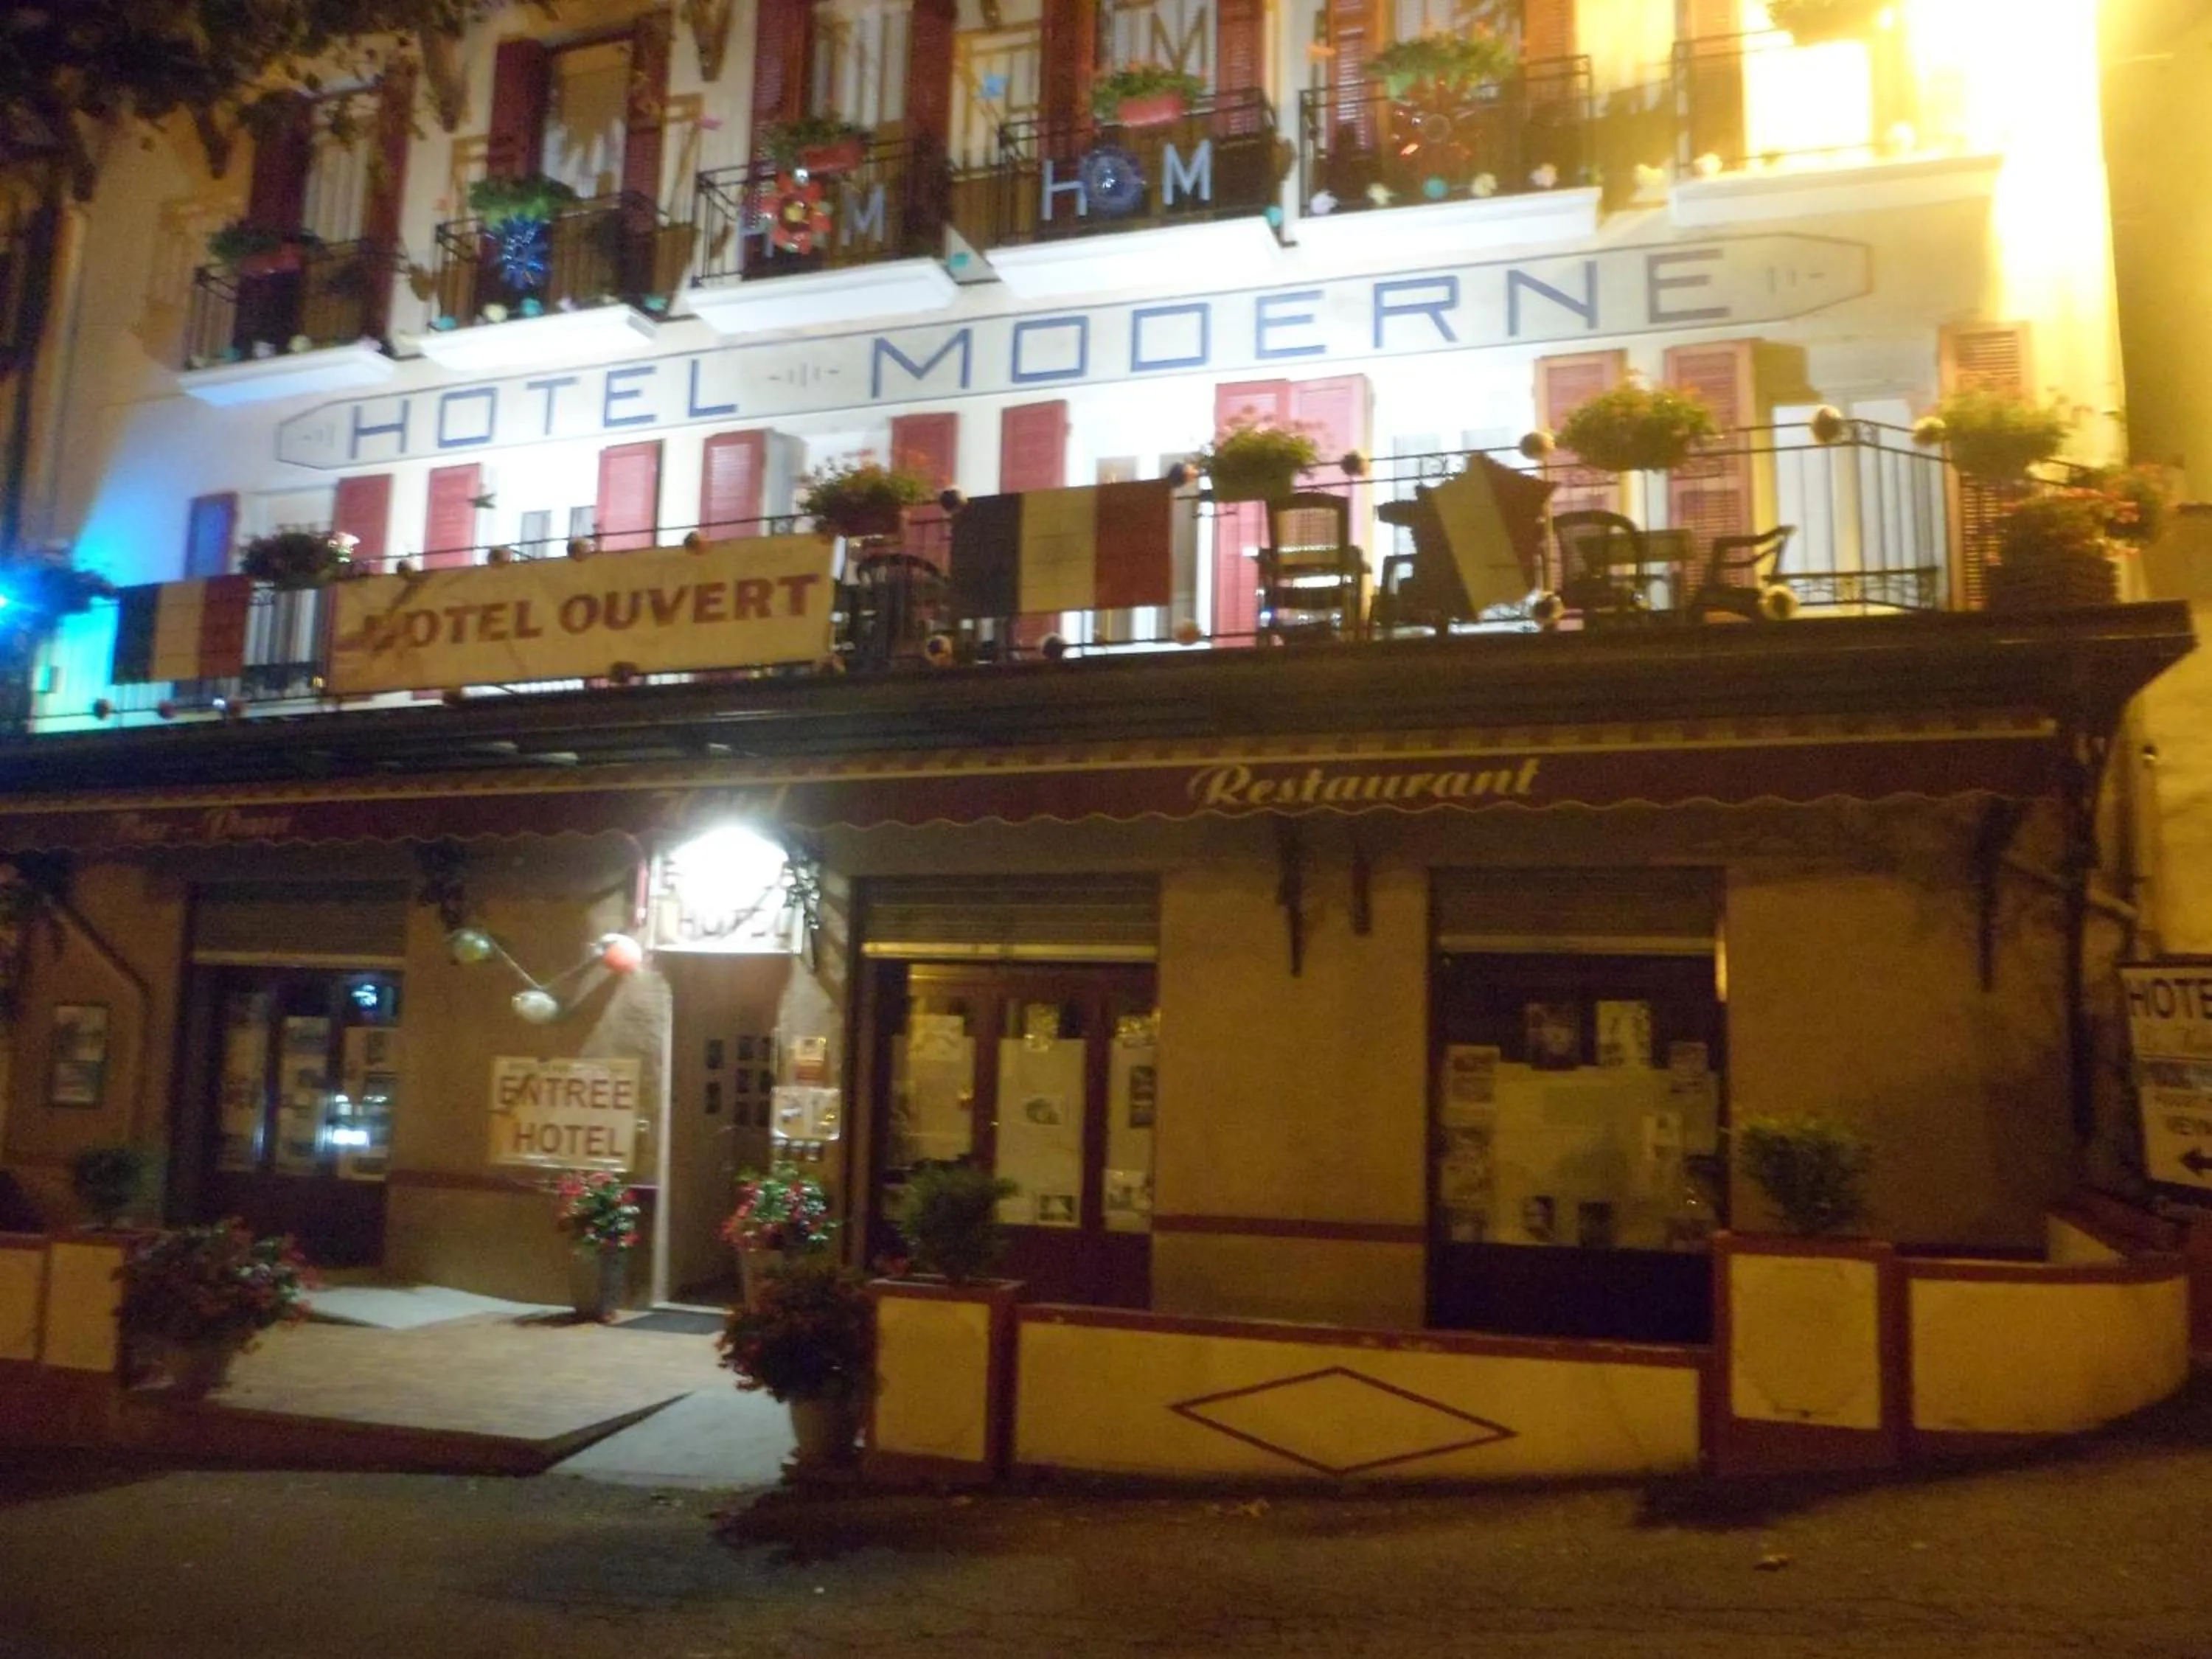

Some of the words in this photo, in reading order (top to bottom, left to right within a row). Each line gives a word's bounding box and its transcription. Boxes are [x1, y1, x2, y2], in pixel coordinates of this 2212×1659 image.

[349, 359, 737, 459] HOTEL
[872, 248, 1731, 399] MODERNE
[558, 574, 820, 633] OUVERT
[1186, 758, 1540, 805] Restaurant
[500, 1074, 633, 1110] ENTREE
[512, 1121, 626, 1157] HOTEL
